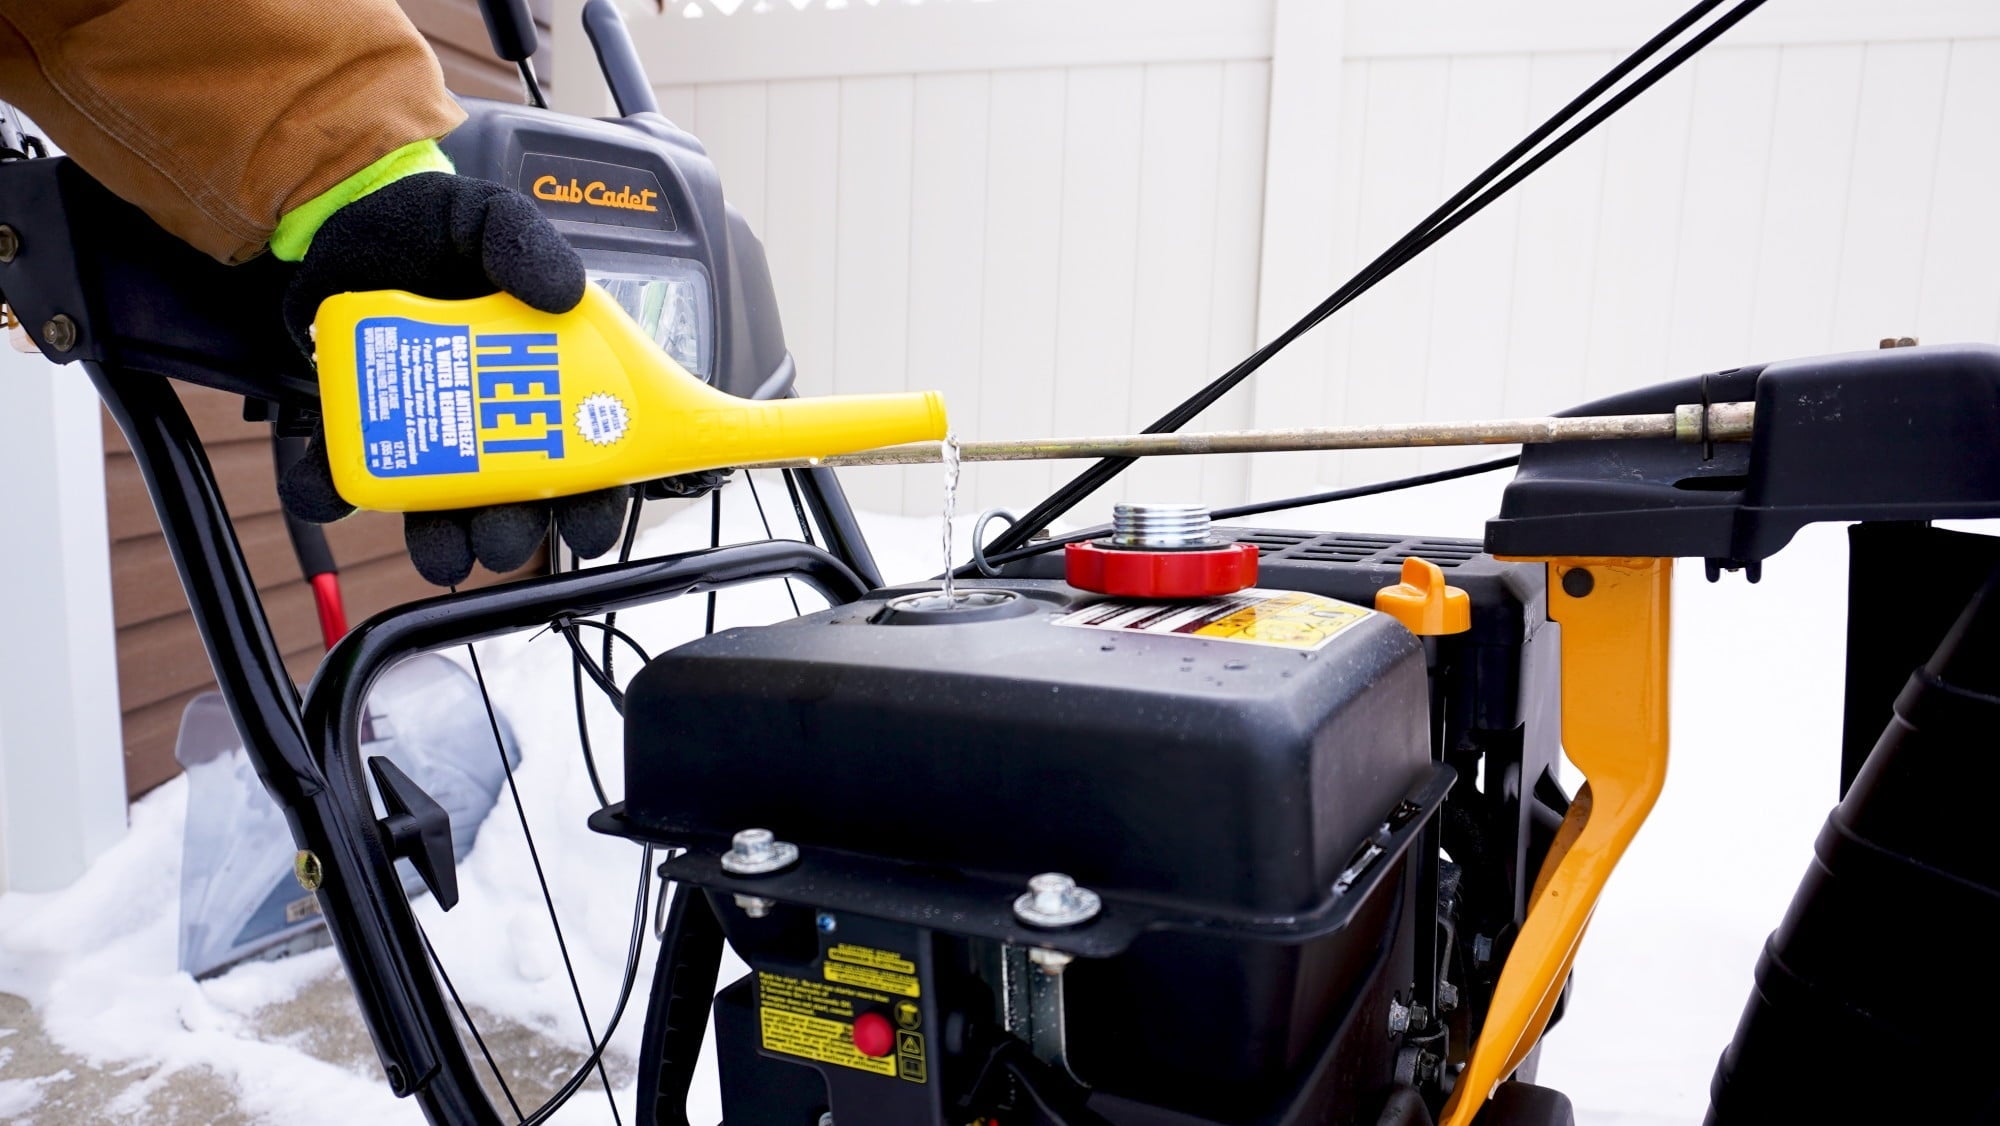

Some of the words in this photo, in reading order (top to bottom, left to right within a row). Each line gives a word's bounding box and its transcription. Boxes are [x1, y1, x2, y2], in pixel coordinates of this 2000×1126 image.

[533, 175, 583, 204] Cub
[584, 181, 658, 212] Cadet
[435, 336, 450, 347] &
[436, 350, 453, 388] WATER
[451, 335, 469, 387] GAS-LINE
[475, 332, 565, 459] HEET
[428, 417, 438, 442] Starts
[439, 391, 457, 446] REMOVER
[455, 389, 474, 456] ANTIFREEZE
[378, 440, 393, 455] (355
[393, 440, 404, 449] 12
[395, 458, 407, 469] OZ
